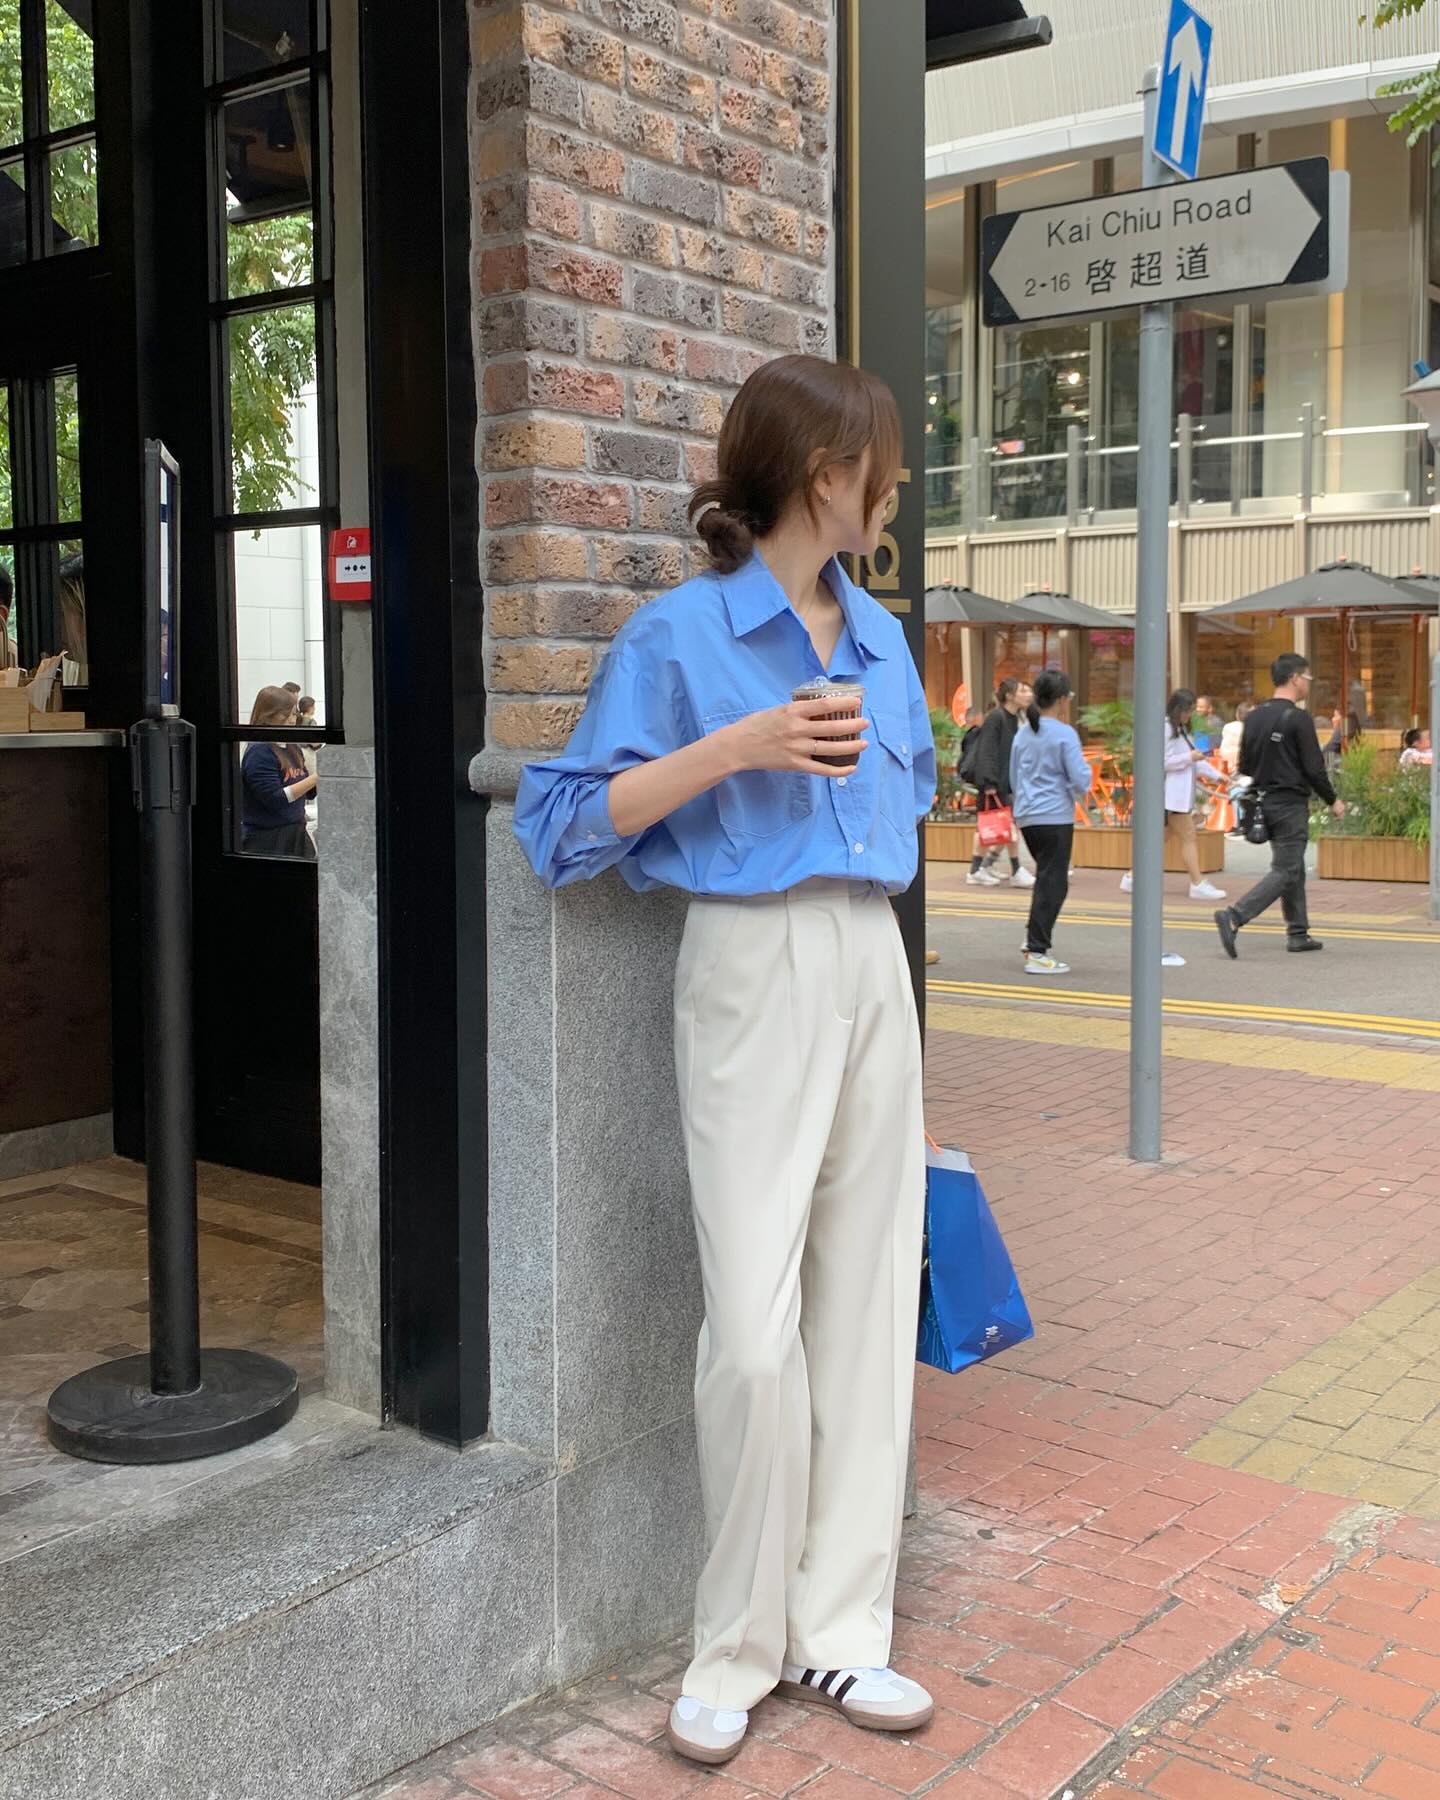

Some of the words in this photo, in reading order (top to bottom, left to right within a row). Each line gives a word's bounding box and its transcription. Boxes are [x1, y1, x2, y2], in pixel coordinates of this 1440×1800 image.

[1046, 216, 1091, 247] Kai
[1102, 207, 1161, 237] Chiu
[1173, 189, 1252, 227] Road
